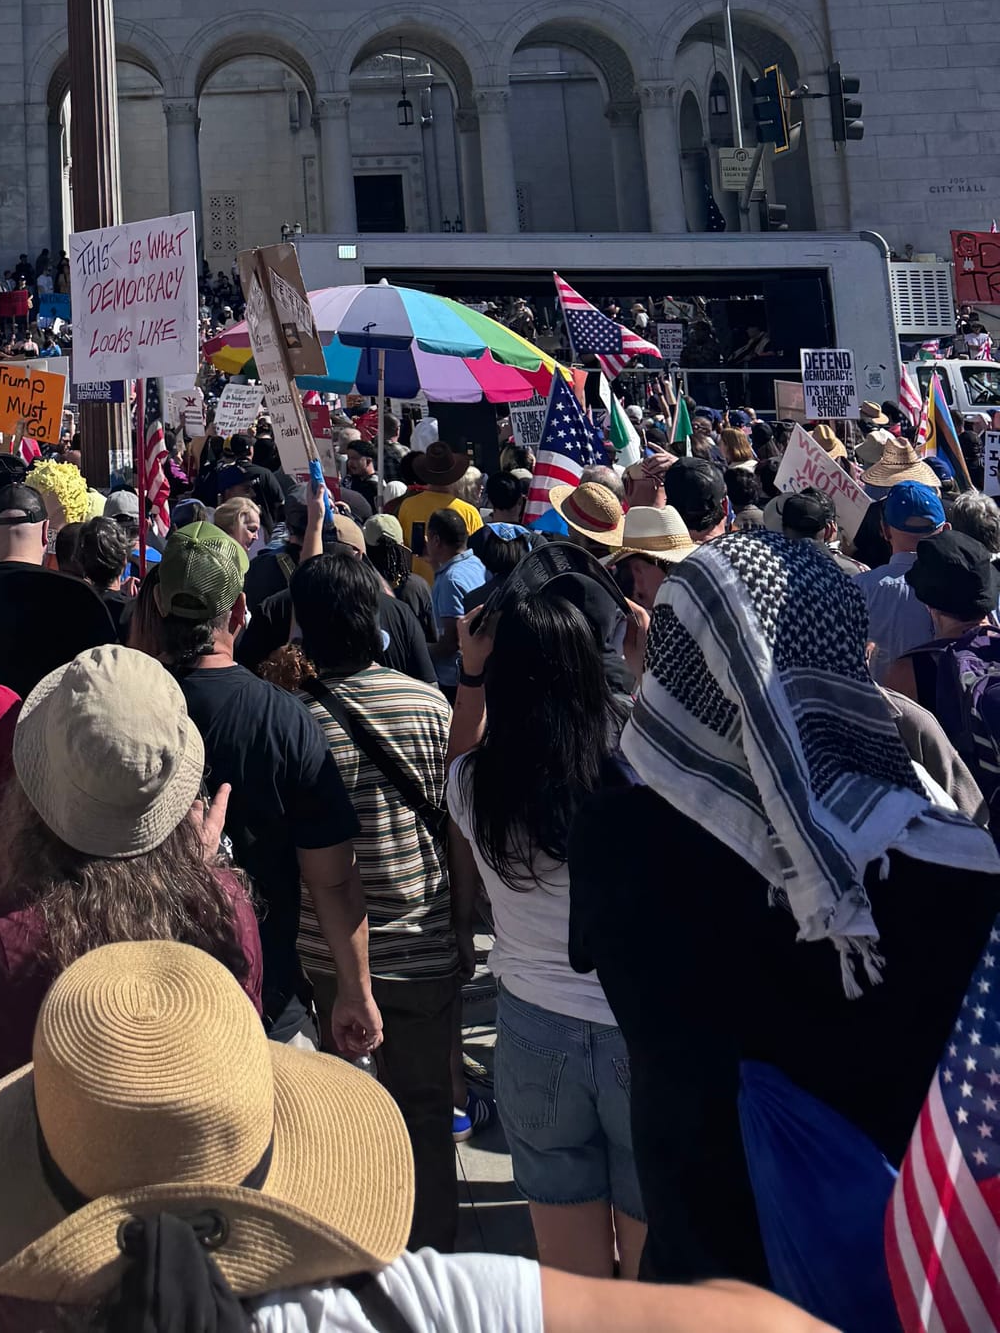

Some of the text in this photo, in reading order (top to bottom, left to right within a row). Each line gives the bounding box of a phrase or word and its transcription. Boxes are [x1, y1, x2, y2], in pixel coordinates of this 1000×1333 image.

[929, 184, 987, 194] CITY HALL
[77, 227, 188, 276] THIS IS WHAT
[87, 266, 185, 315] DEMOCRACY
[89, 319, 178, 358] LOOKS LIKE
[804, 352, 851, 370] DEFEND
[804, 370, 853, 381] DEMOCRACY:
[806, 385, 855, 396] IT'S TIME FOR
[6, 396, 47, 421] Must
[812, 396, 851, 406] A GENERAL
[817, 406, 847, 417] STRIKE!
[26, 418, 52, 439] Go!
[802, 458, 839, 499] NOT
